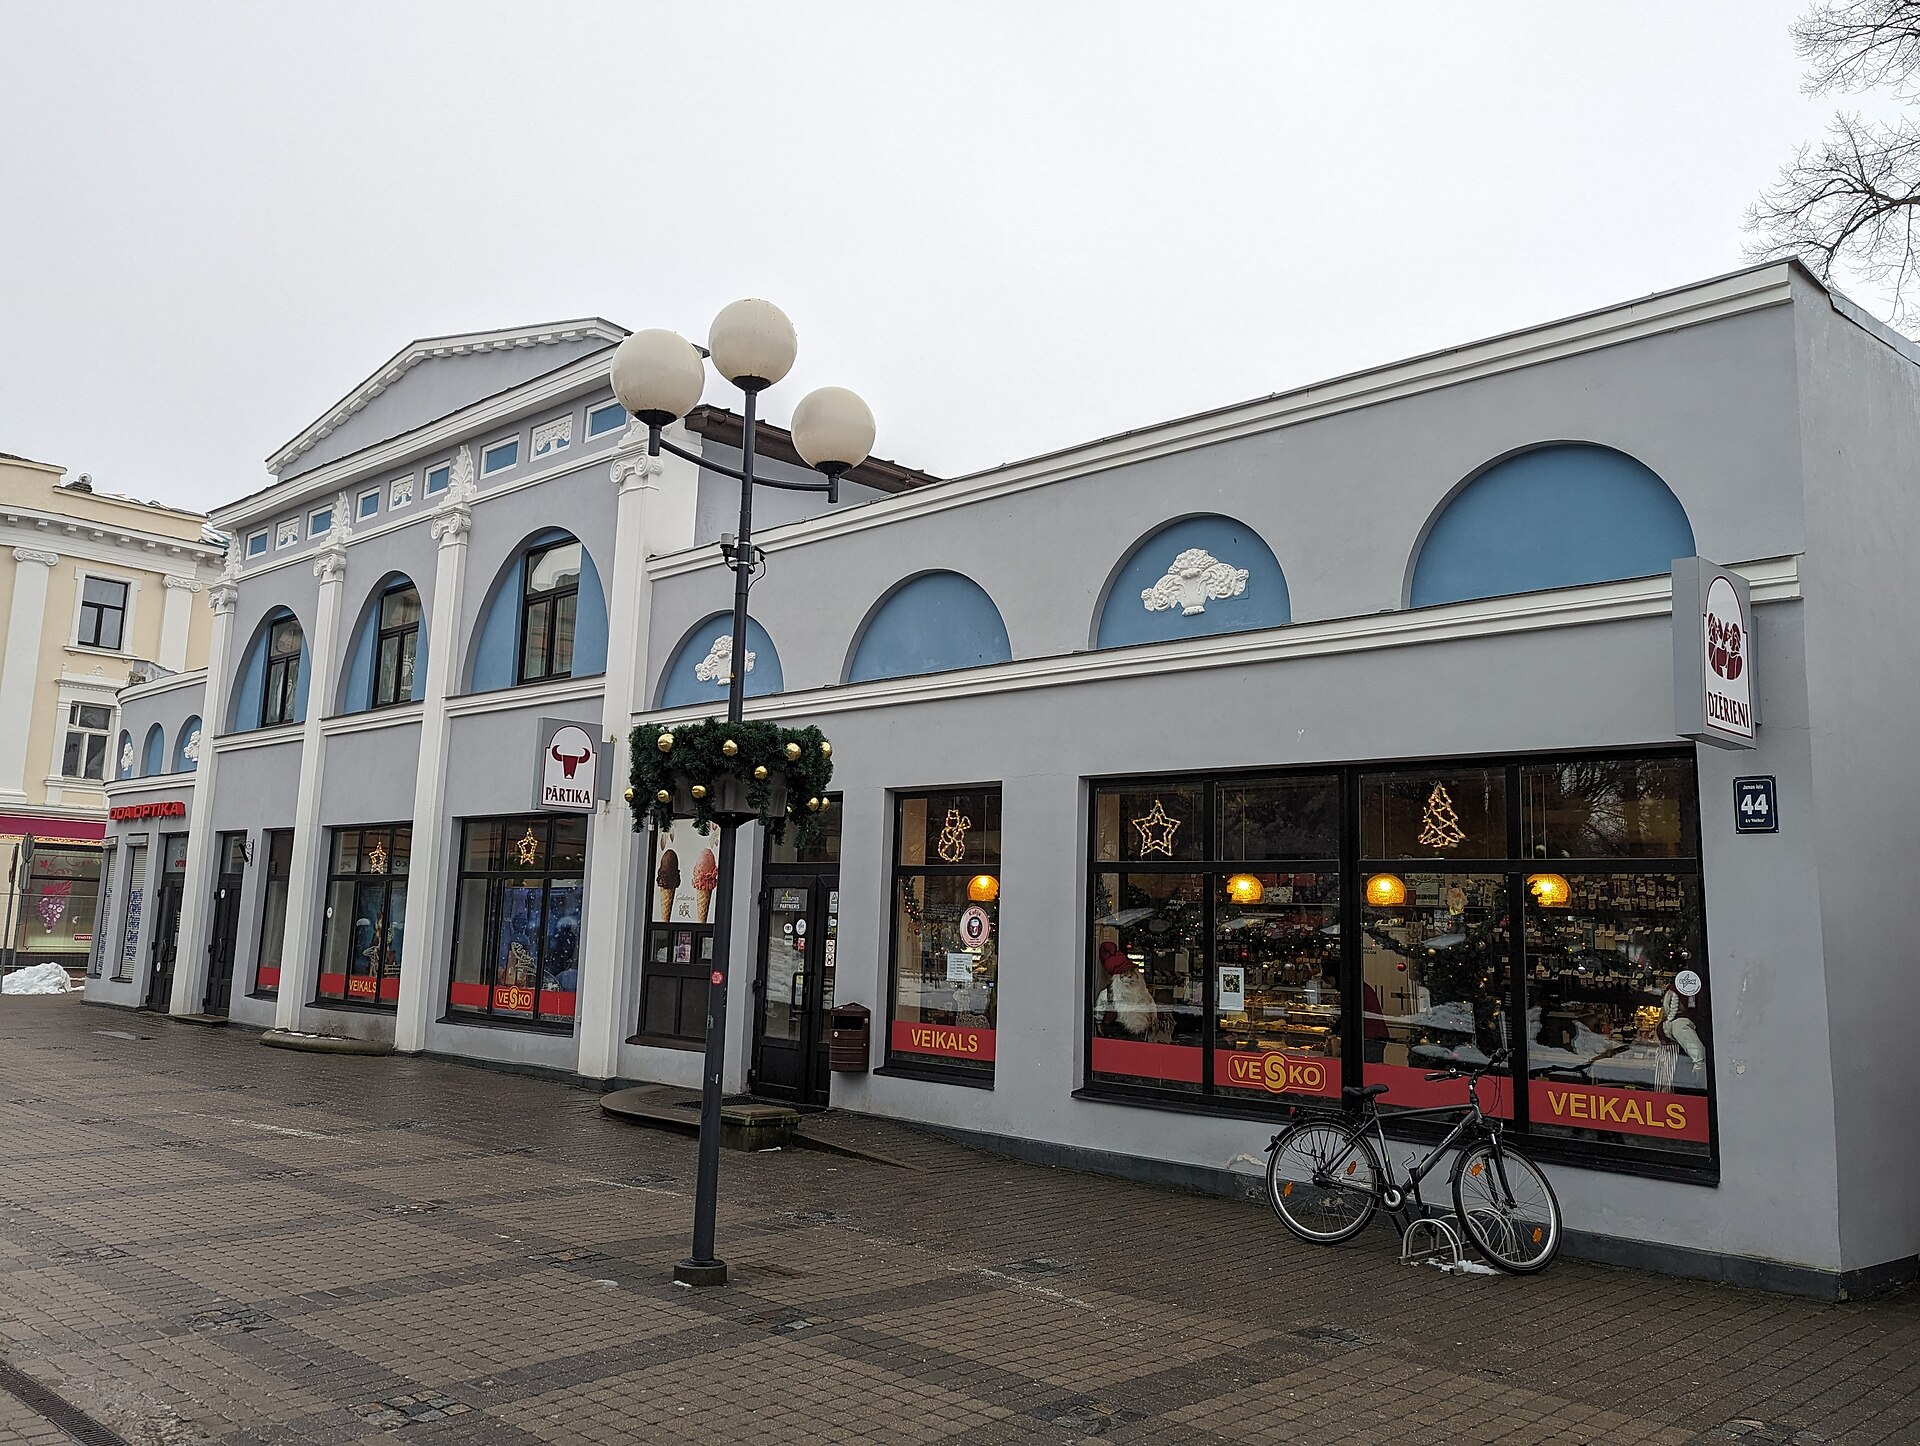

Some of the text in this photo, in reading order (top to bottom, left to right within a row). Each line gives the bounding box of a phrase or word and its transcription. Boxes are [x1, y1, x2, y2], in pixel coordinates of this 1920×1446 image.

[1707, 690, 1750, 728] DZĒRIENI
[545, 785, 591, 804] PĀRTIKA
[1741, 793, 1769, 815] 44
[134, 802, 183, 818] OPTIKA
[349, 979, 377, 993] VEIKALS
[498, 987, 531, 1009] VESKO
[911, 1028, 978, 1053] VEIKALS
[1233, 1055, 1321, 1089] VESKO
[1547, 1090, 1687, 1129] VEIKALS
